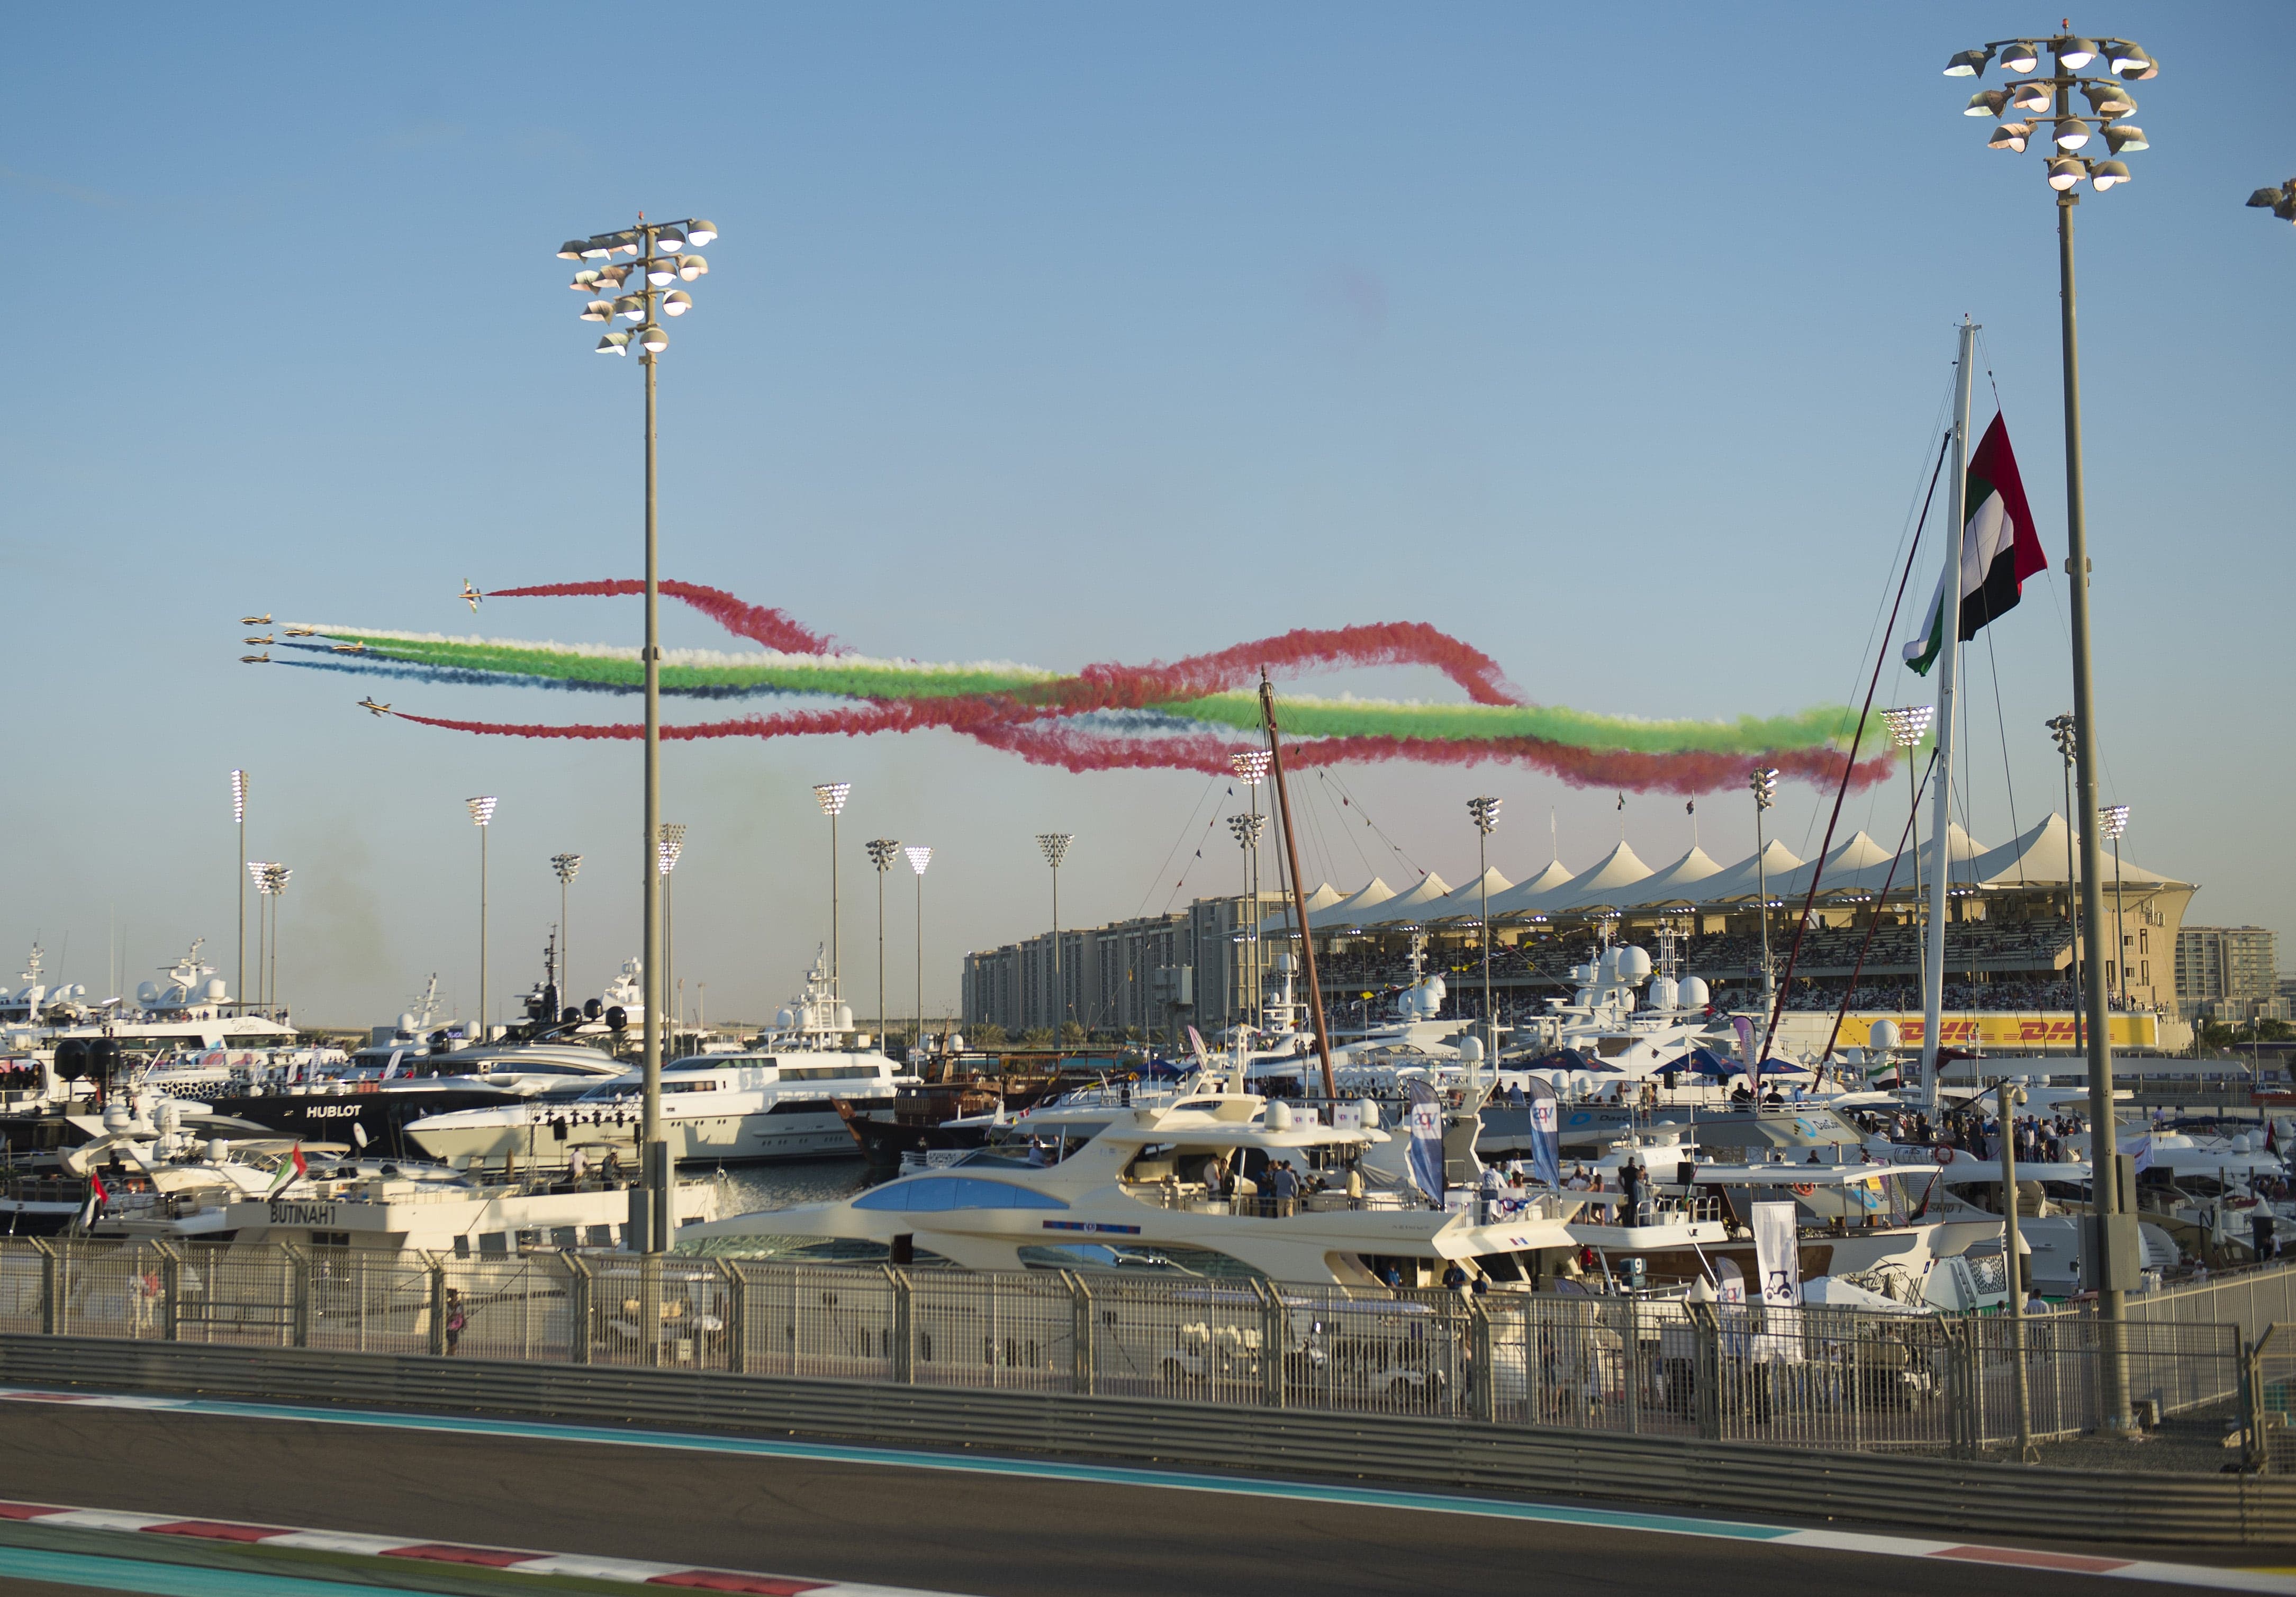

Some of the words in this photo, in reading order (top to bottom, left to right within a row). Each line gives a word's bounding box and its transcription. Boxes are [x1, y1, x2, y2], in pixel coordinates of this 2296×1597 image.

[1899, 1022, 1976, 1040] DHL
[306, 1105, 362, 1118] HUBLOT
[1635, 1258, 1642, 1274] 9
